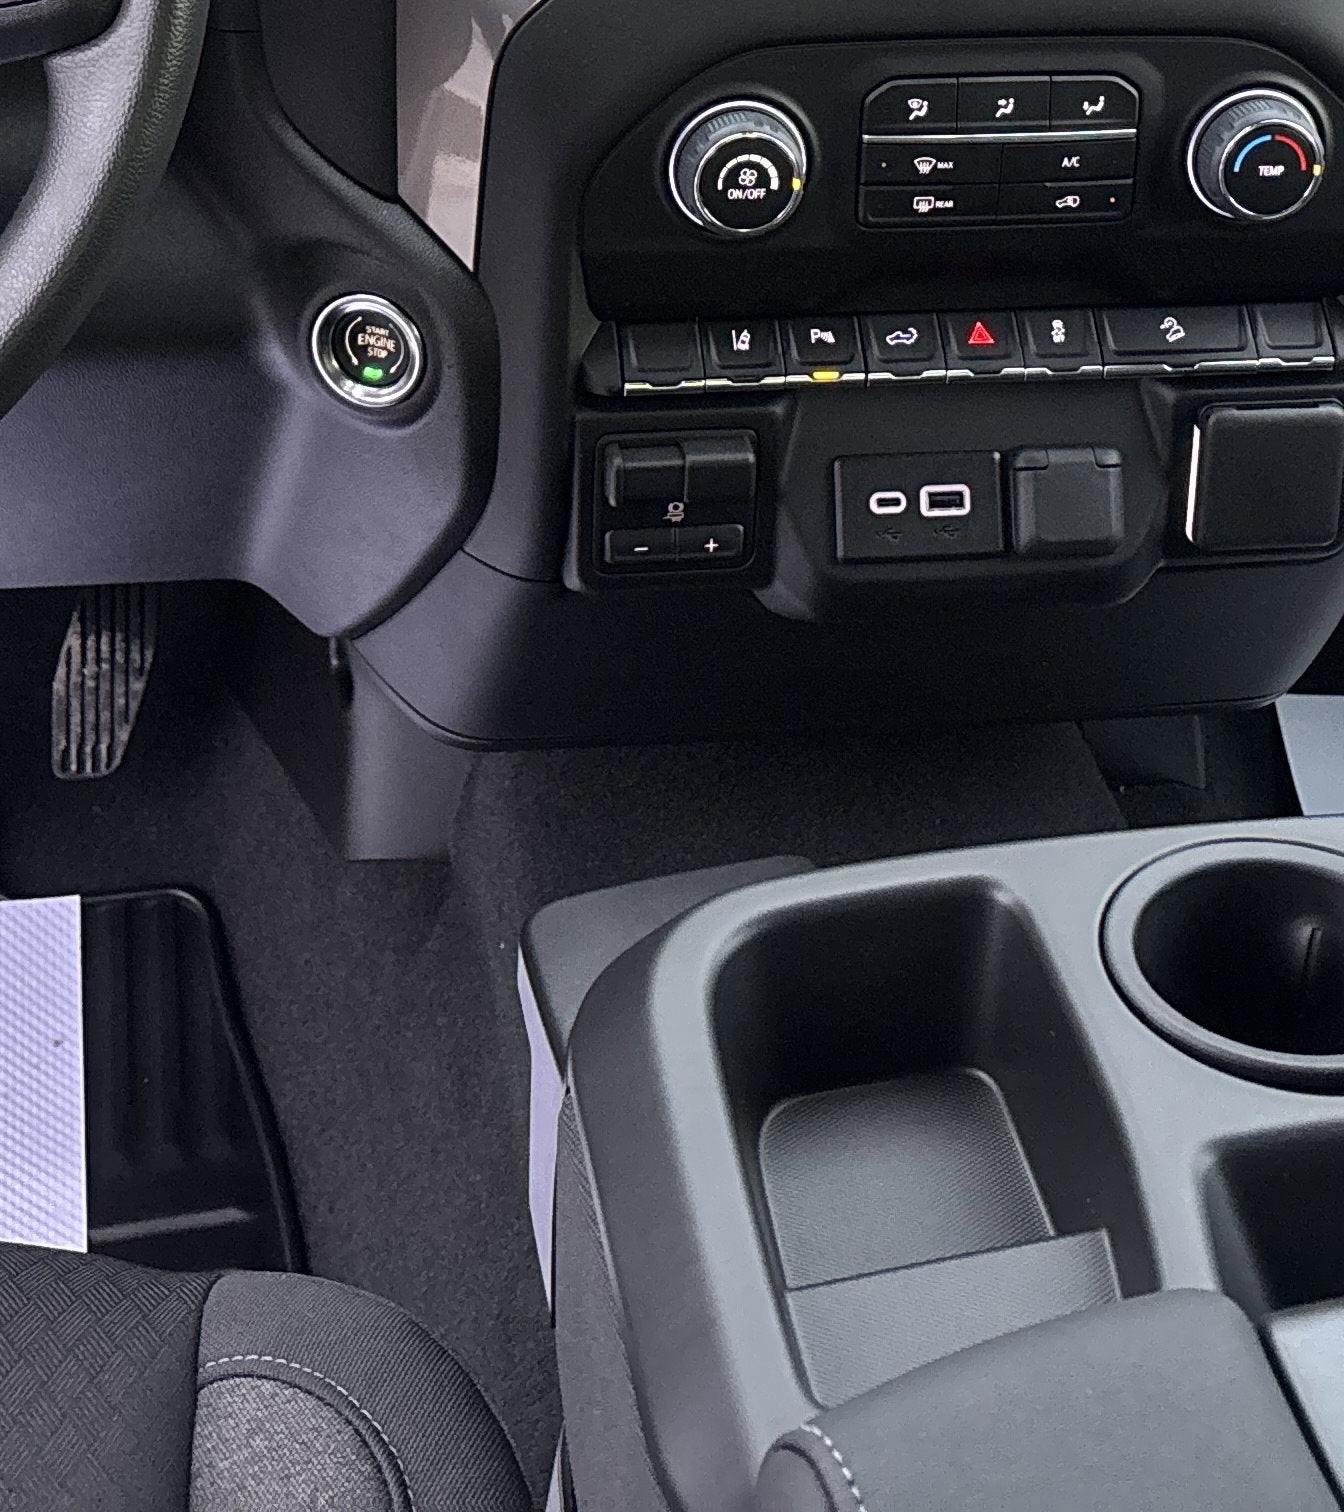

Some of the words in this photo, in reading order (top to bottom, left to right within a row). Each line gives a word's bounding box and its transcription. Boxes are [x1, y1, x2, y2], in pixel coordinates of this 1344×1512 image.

[937, 161, 954, 169] MAX
[1061, 156, 1080, 168] A/C
[1258, 165, 1285, 176] TEMP
[727, 188, 766, 199] ON/OFF
[366, 325, 389, 337] START
[357, 332, 396, 353] ENGINE
[367, 346, 388, 358] STOP
